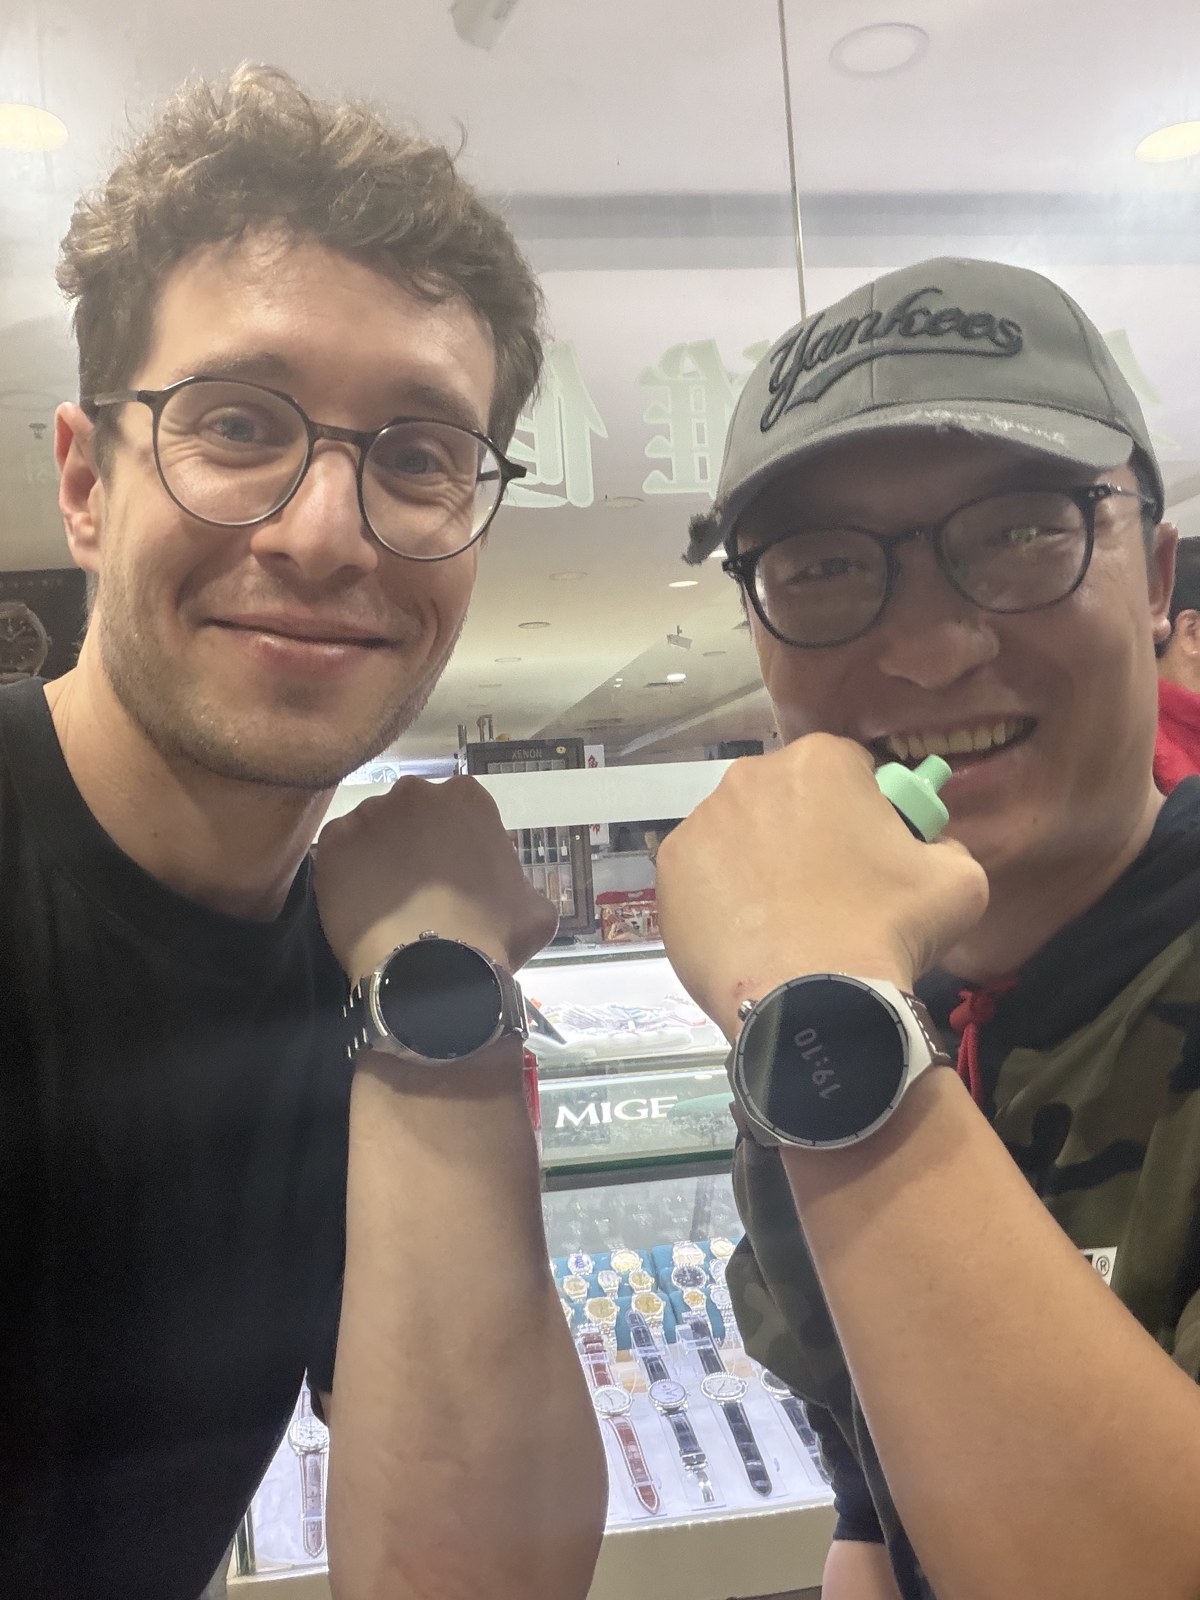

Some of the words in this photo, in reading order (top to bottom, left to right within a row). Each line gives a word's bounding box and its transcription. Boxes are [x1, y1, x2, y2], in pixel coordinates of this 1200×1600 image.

[760, 287, 1023, 432] Yankees
[794, 1028, 840, 1100] 19:10
[555, 1095, 678, 1128] MIGE
